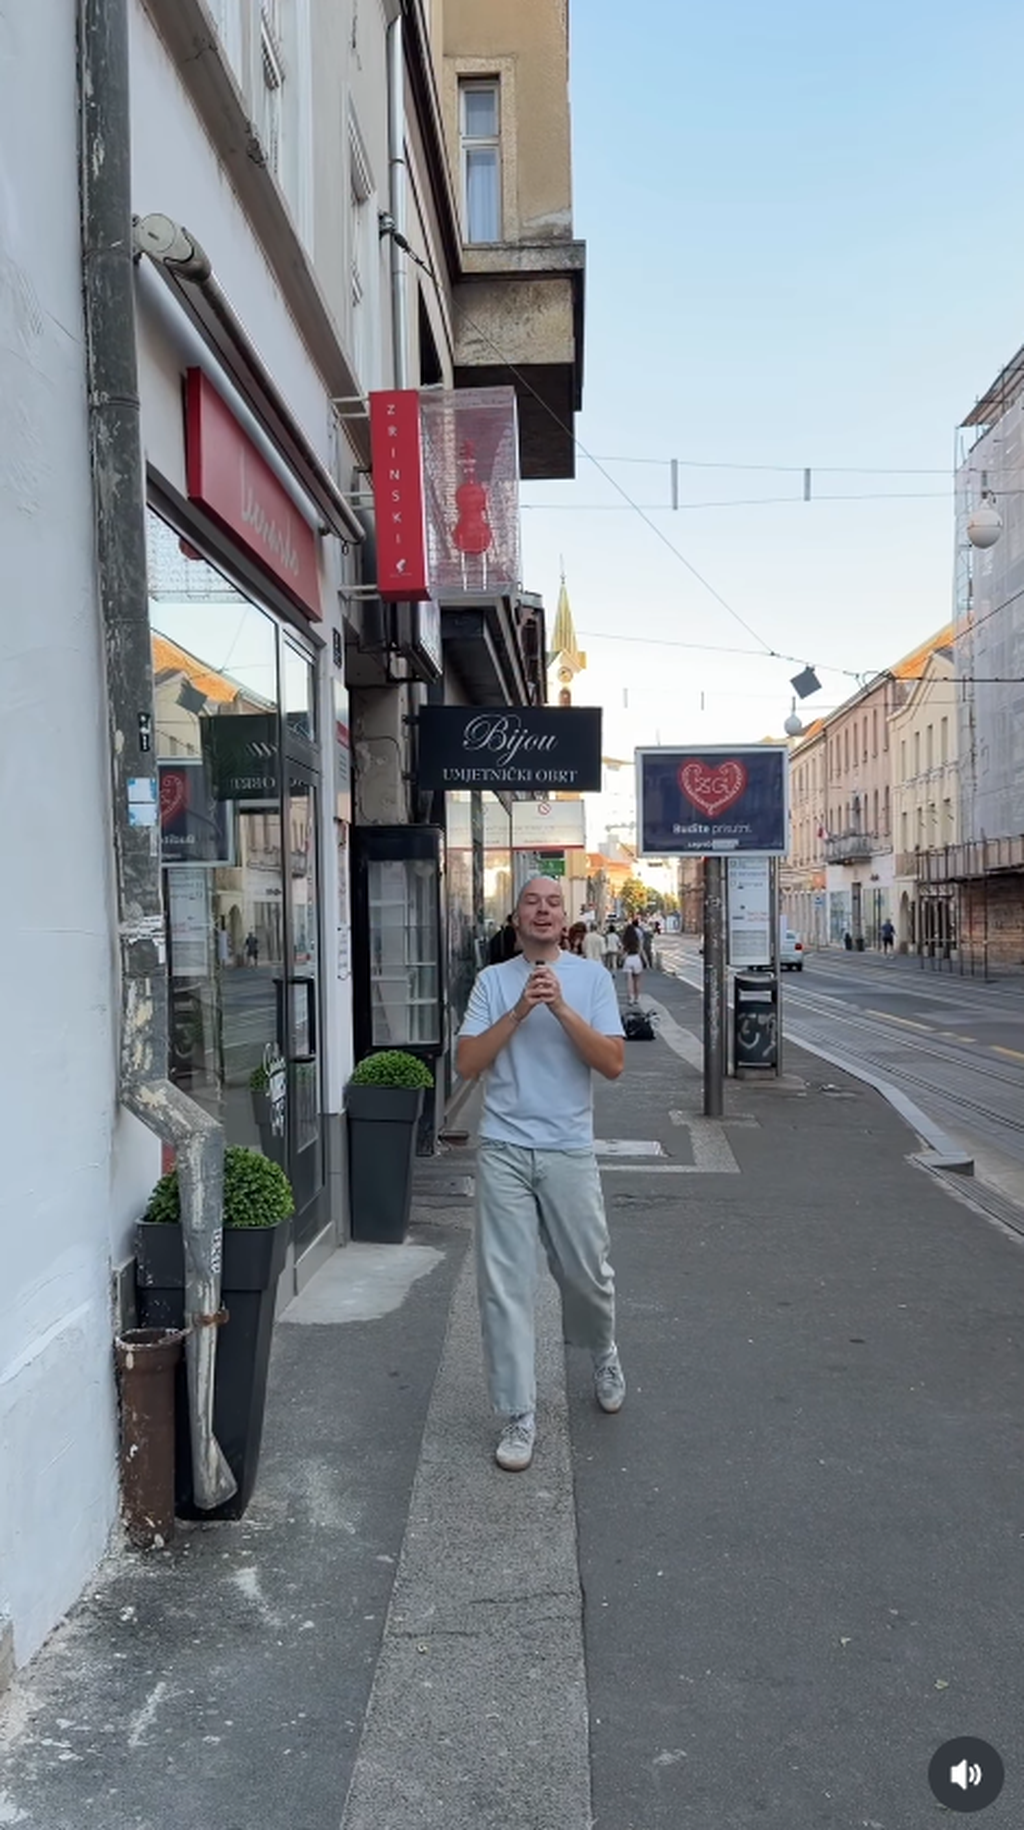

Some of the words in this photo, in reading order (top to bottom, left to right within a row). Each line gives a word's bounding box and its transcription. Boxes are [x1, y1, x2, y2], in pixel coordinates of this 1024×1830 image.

[386, 403, 402, 544] ZRINSKI
[462, 713, 558, 767] Bijou
[443, 767, 532, 784] UMJETNIČKI
[535, 769, 578, 784] OBRT
[672, 823, 710, 835] Budite
